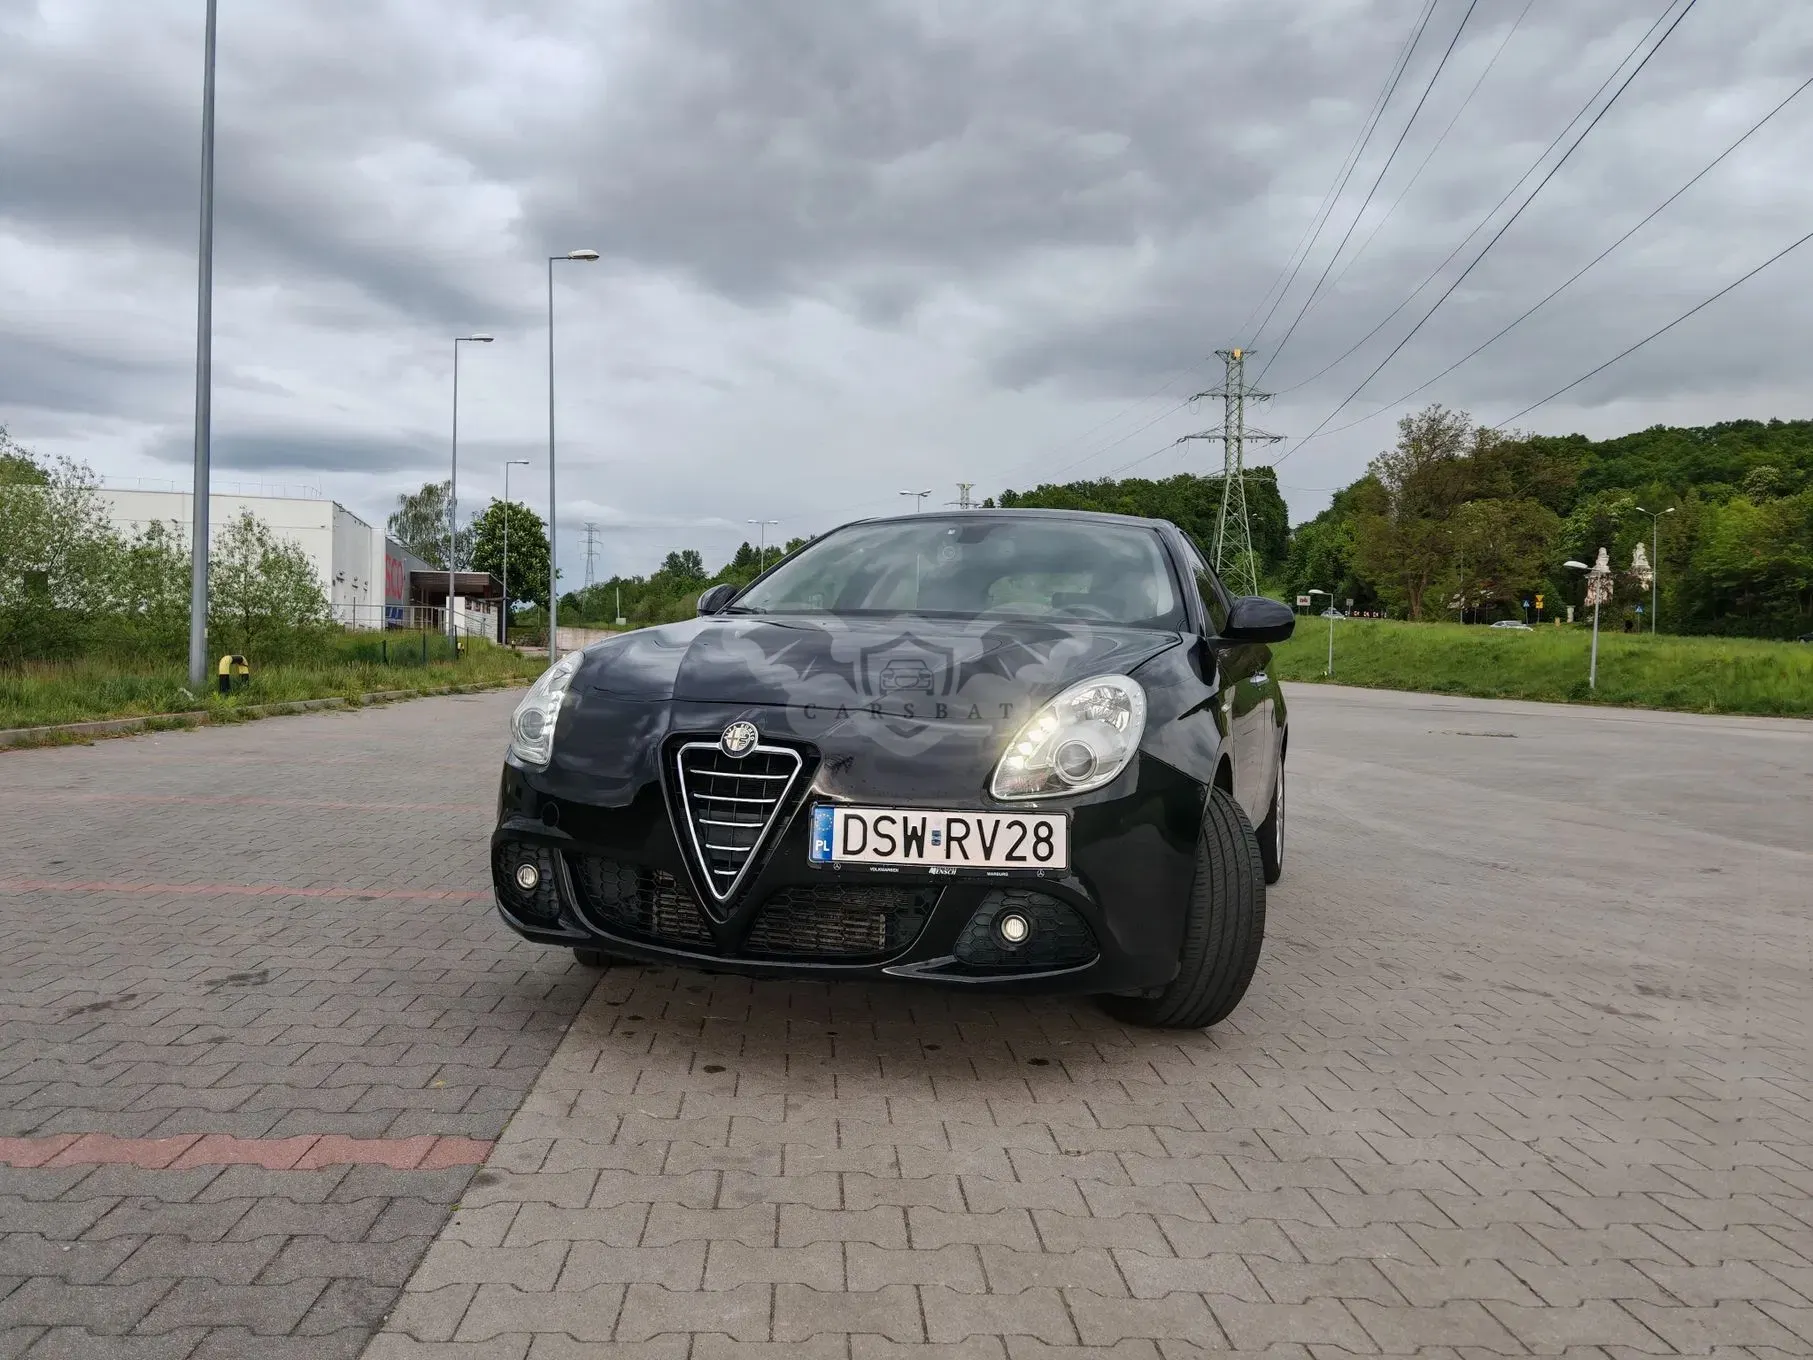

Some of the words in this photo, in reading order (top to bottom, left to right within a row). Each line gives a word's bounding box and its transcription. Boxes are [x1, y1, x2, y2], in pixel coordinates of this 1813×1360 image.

[815, 839, 830, 852] PL
[842, 813, 927, 858] DSW
[945, 817, 1055, 862] RV28
